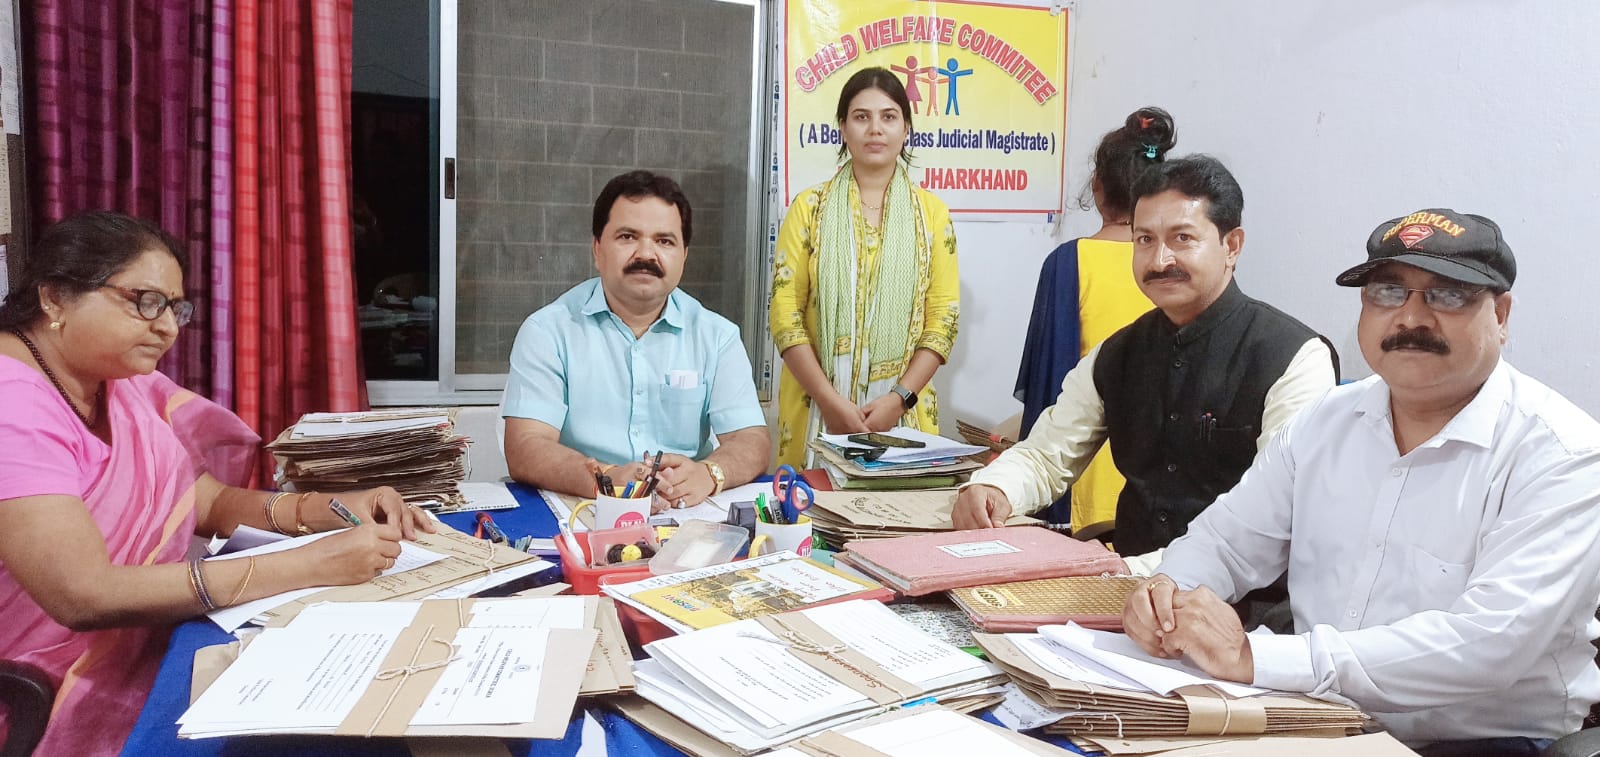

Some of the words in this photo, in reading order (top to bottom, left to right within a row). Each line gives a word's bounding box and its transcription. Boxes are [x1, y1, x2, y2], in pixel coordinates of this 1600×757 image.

[795, 34, 859, 92] CHILD
[859, 15, 956, 52] WELFARE
[957, 23, 1056, 105] COMMITEE
[936, 128, 982, 150] Judicial
[986, 130, 1049, 155] Magistrate
[919, 167, 1028, 191] JHARKHAND
[1382, 212, 1465, 241] SUPERMAN
